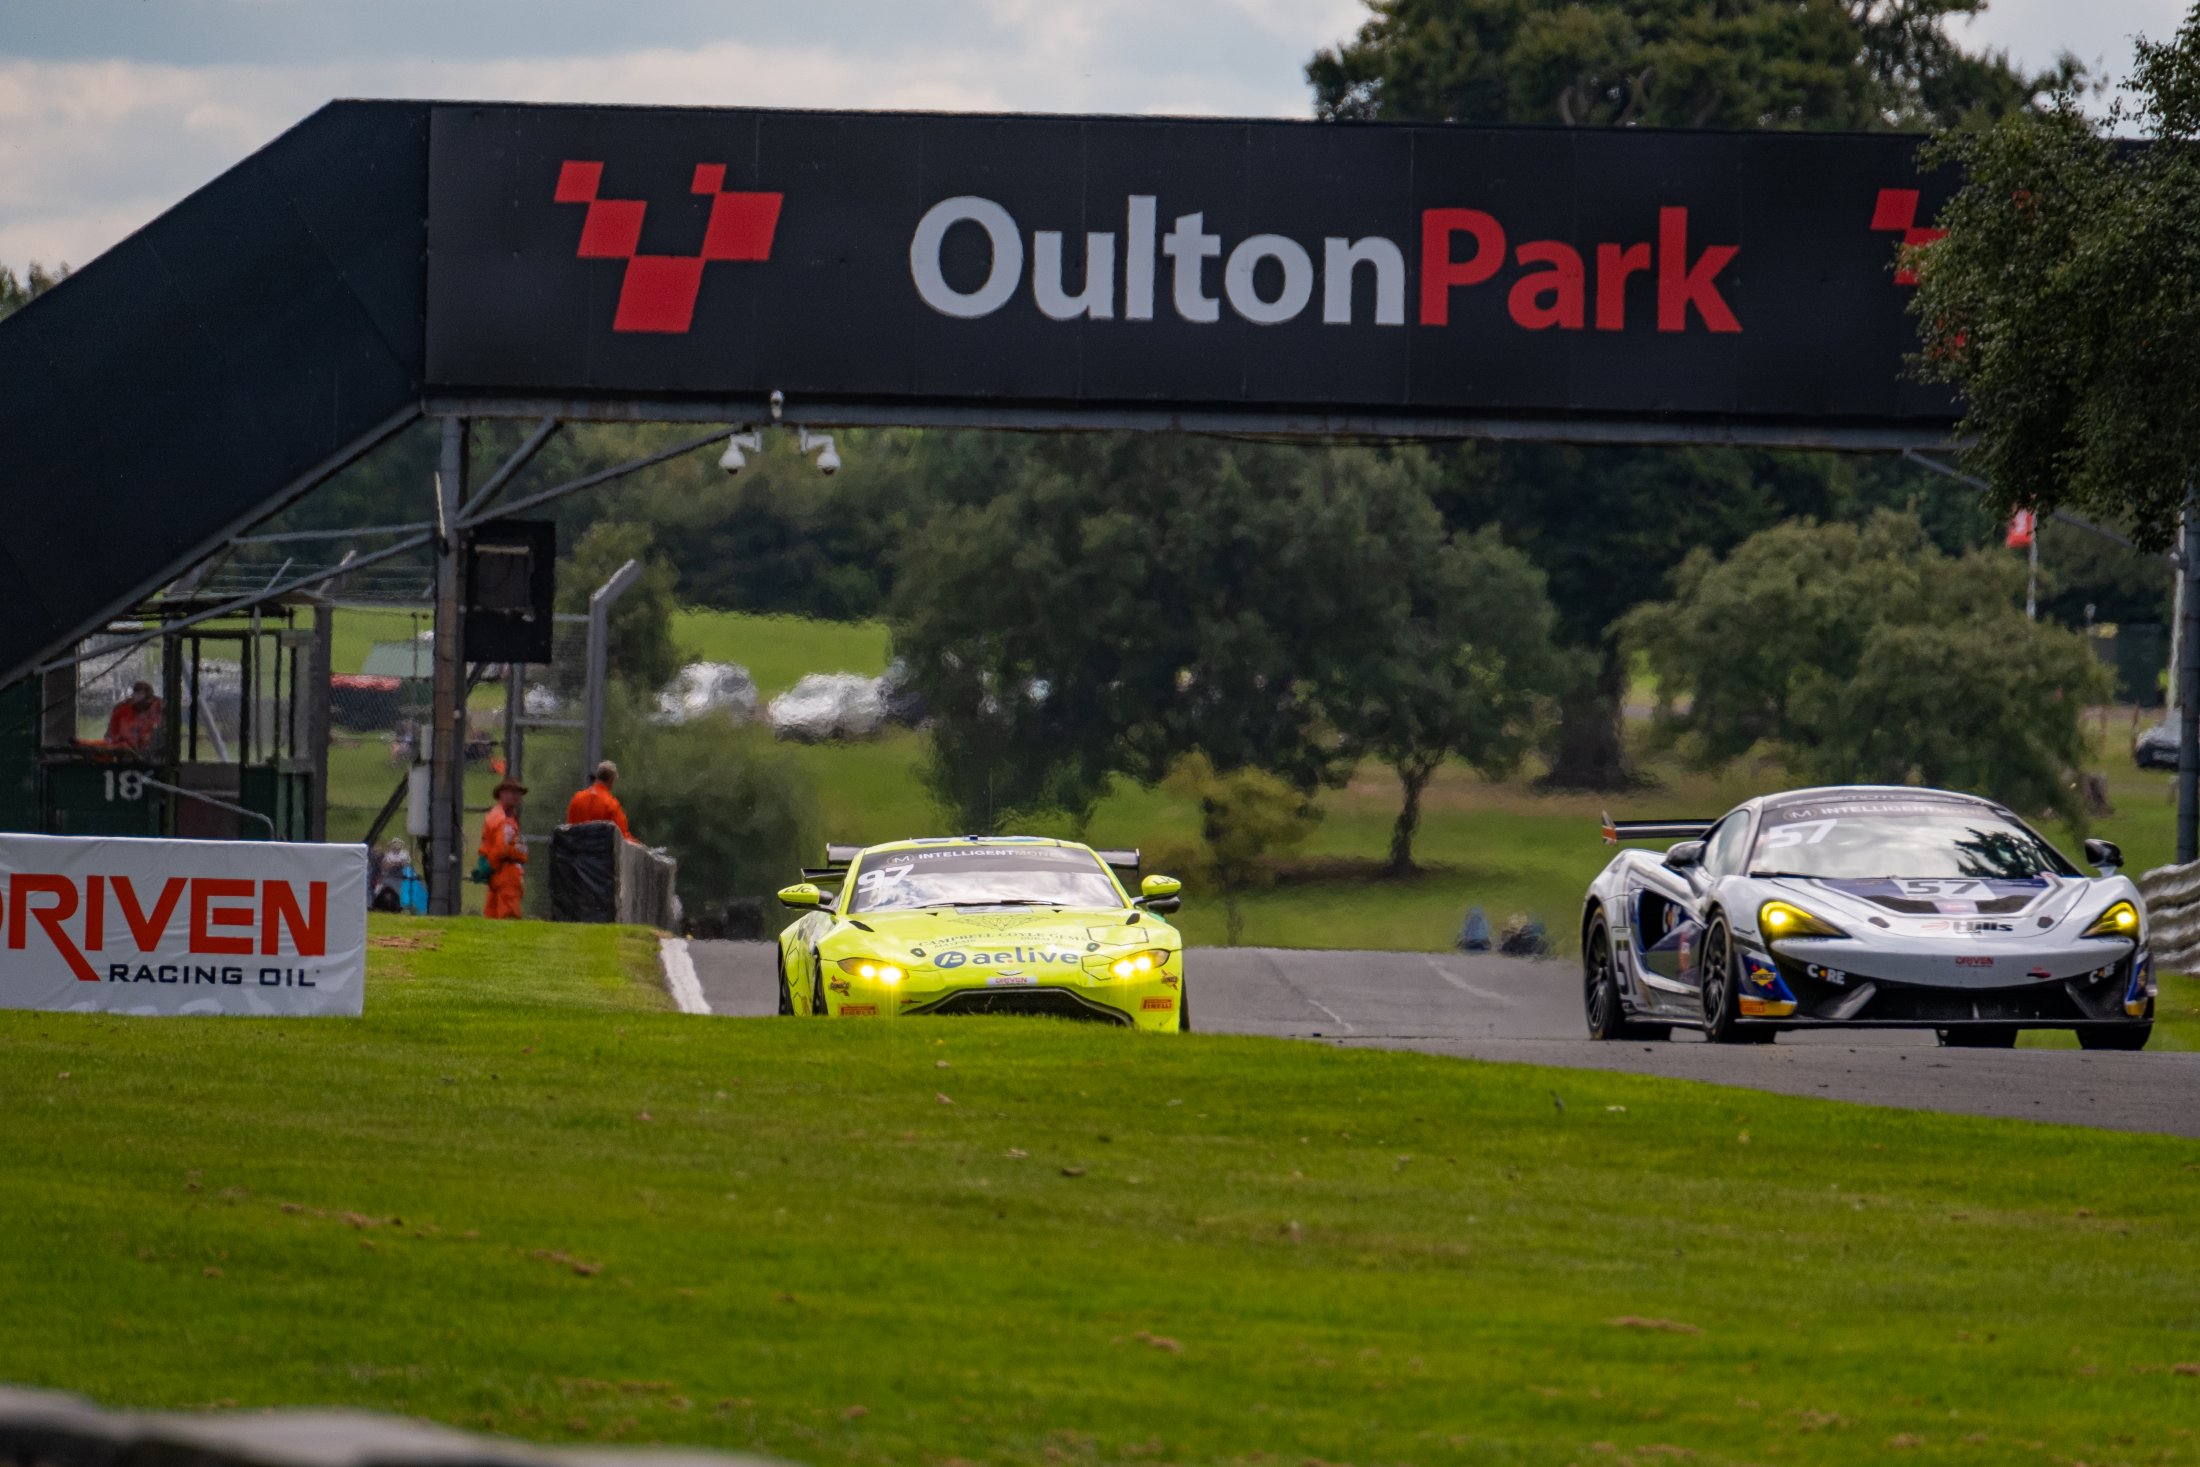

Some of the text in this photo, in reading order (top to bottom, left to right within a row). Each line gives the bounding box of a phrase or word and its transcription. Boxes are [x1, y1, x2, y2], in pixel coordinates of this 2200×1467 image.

[103, 769, 144, 800] 18
[1767, 818, 1837, 849] 57
[857, 864, 914, 894] 97
[1906, 880, 1980, 895] 57
[0, 873, 327, 982] RIVEN
[1955, 956, 1994, 965] DRIVEN
[109, 964, 317, 987] RACING OIL
[1143, 999, 1172, 1009] PIRELLI
